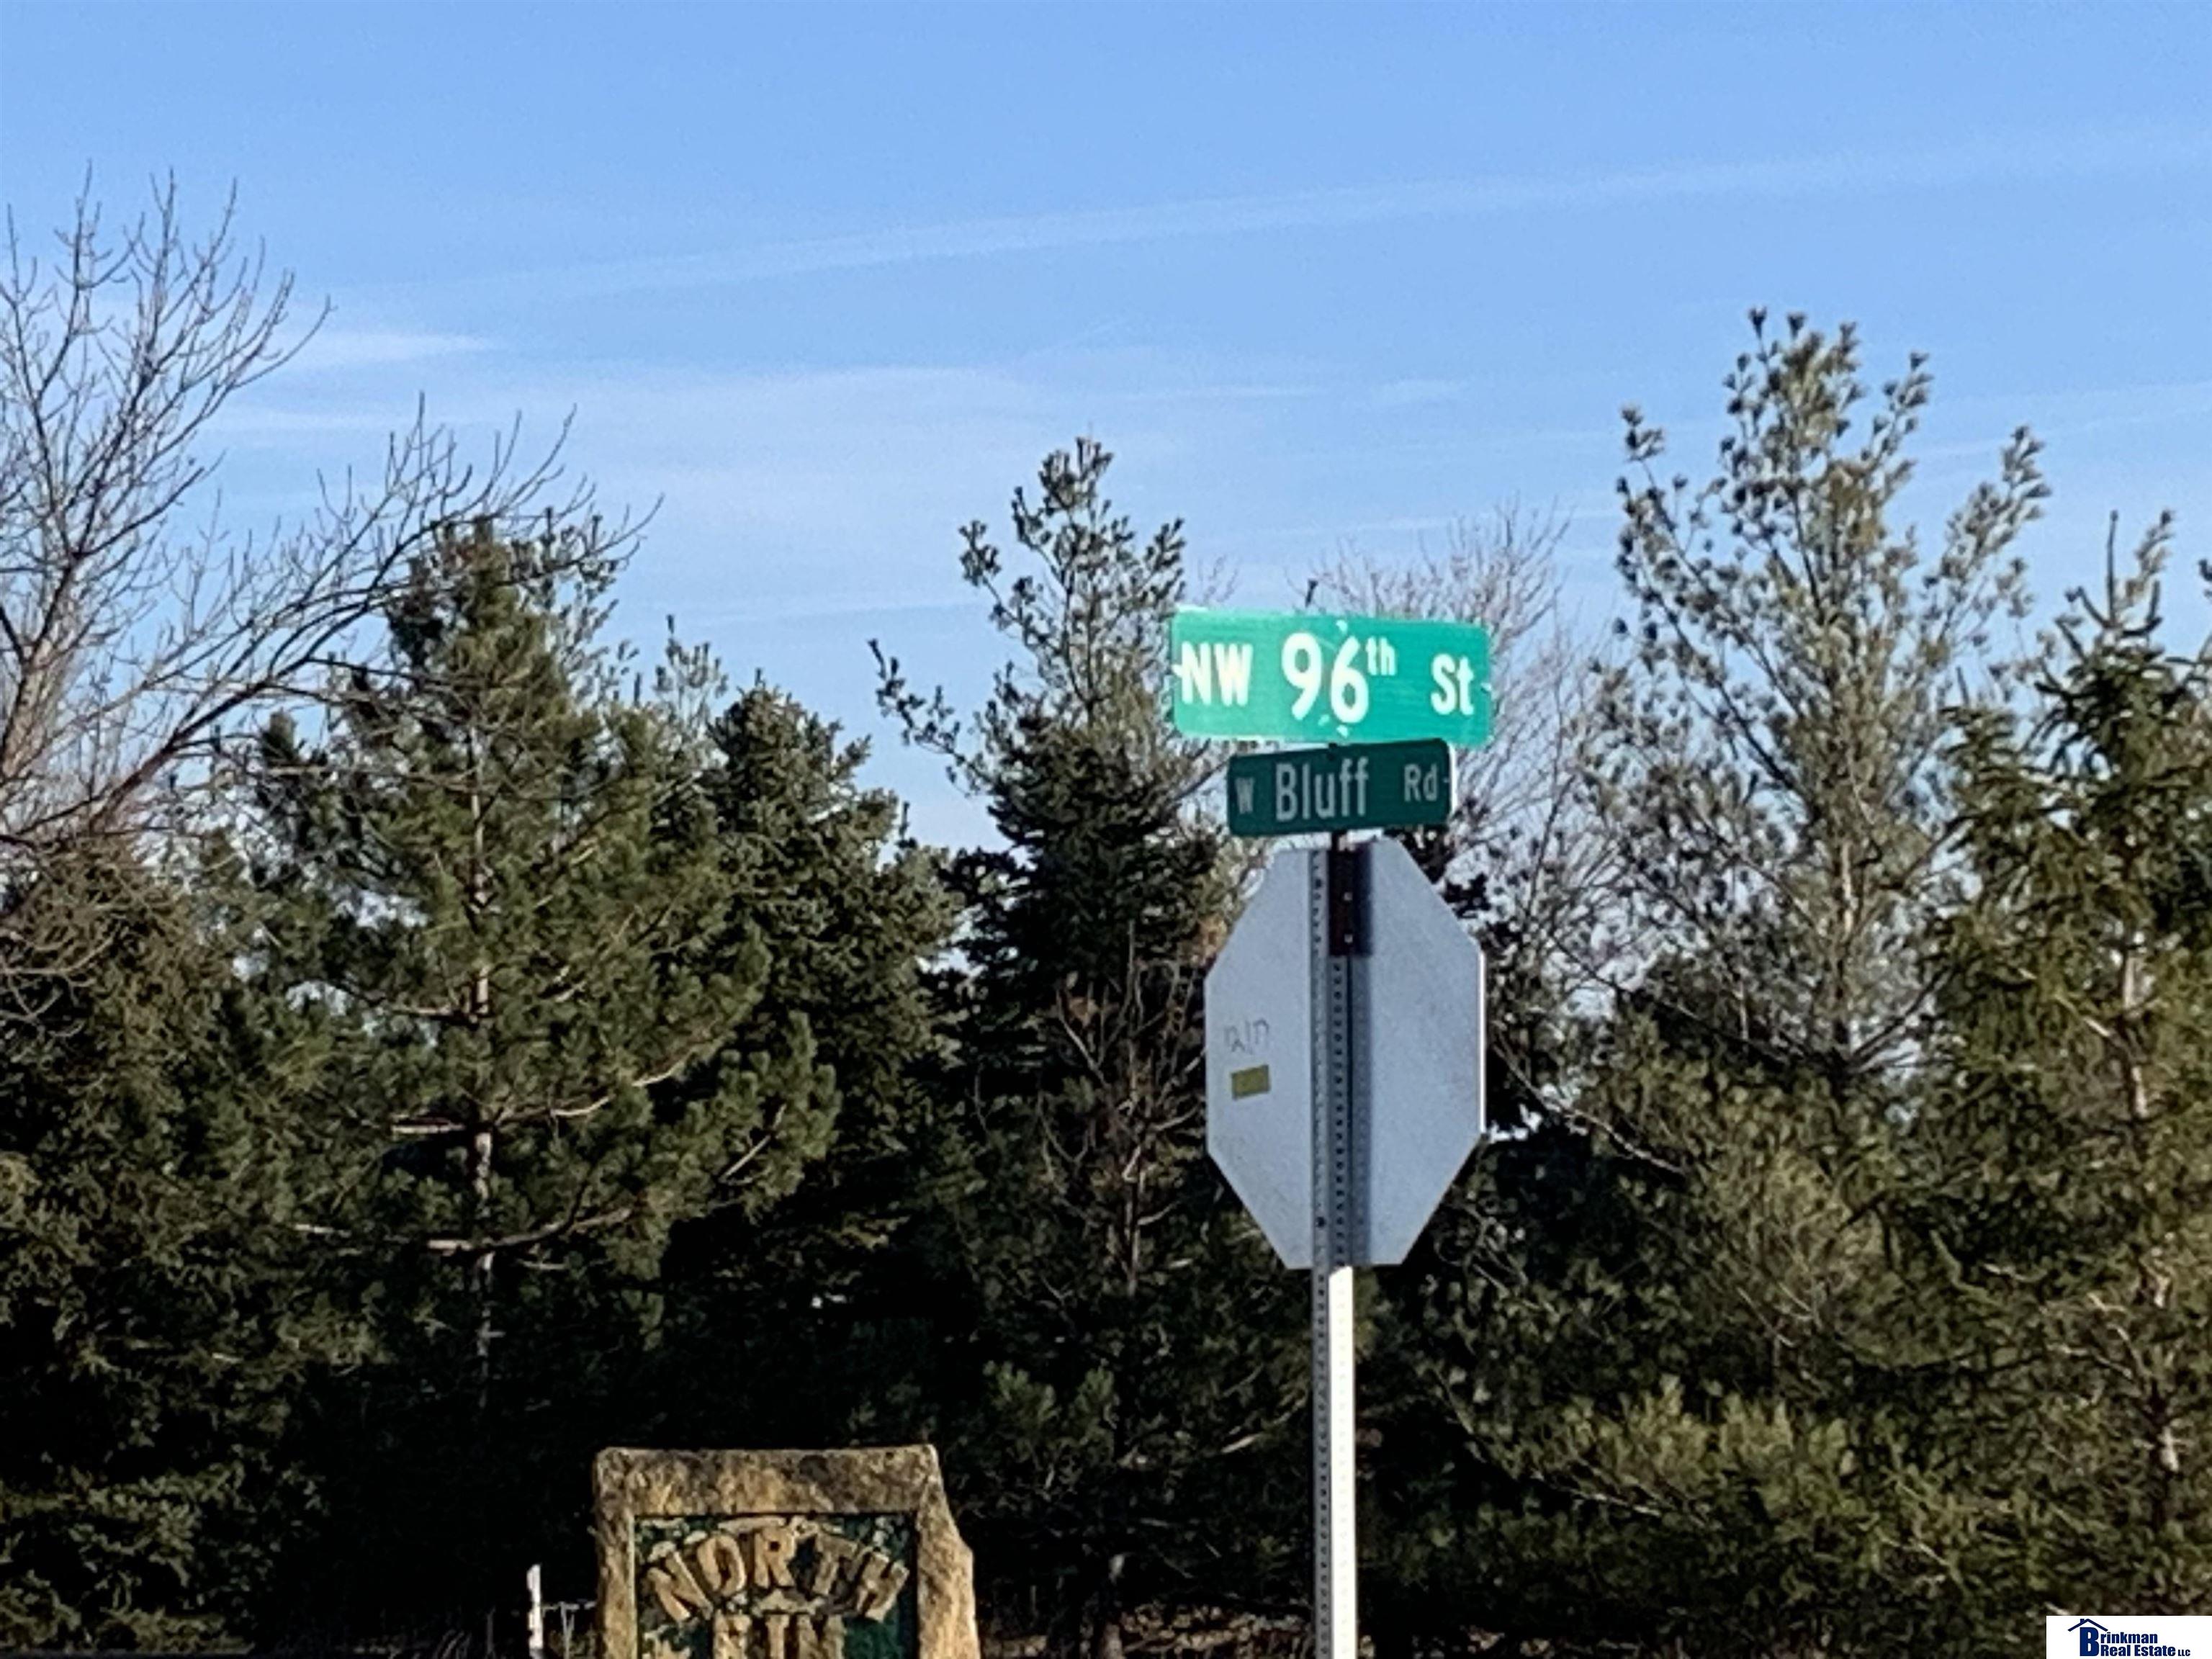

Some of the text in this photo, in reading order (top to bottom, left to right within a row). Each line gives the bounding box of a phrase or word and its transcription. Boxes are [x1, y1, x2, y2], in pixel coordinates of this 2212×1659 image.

[1181, 632, 1474, 723] NW 96th St
[1236, 757, 1439, 822] W Bluff Rd
[647, 1525, 909, 1622] NORTH
